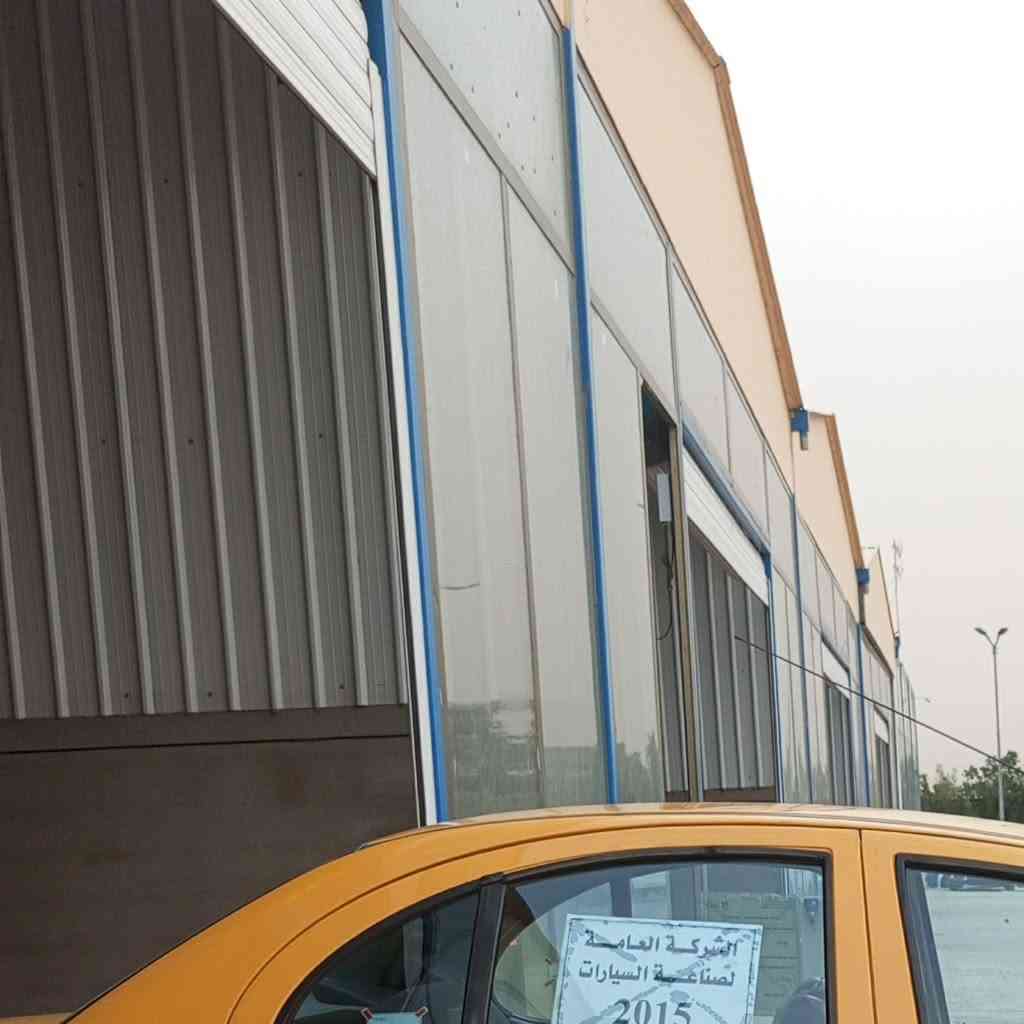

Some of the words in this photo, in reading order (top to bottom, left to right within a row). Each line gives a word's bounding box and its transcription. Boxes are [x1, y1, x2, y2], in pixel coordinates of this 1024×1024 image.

[584, 928, 660, 950] العامة
[666, 934, 738, 960] الشركة
[578, 959, 648, 985] السيارات
[653, 964, 736, 987] لصناعة
